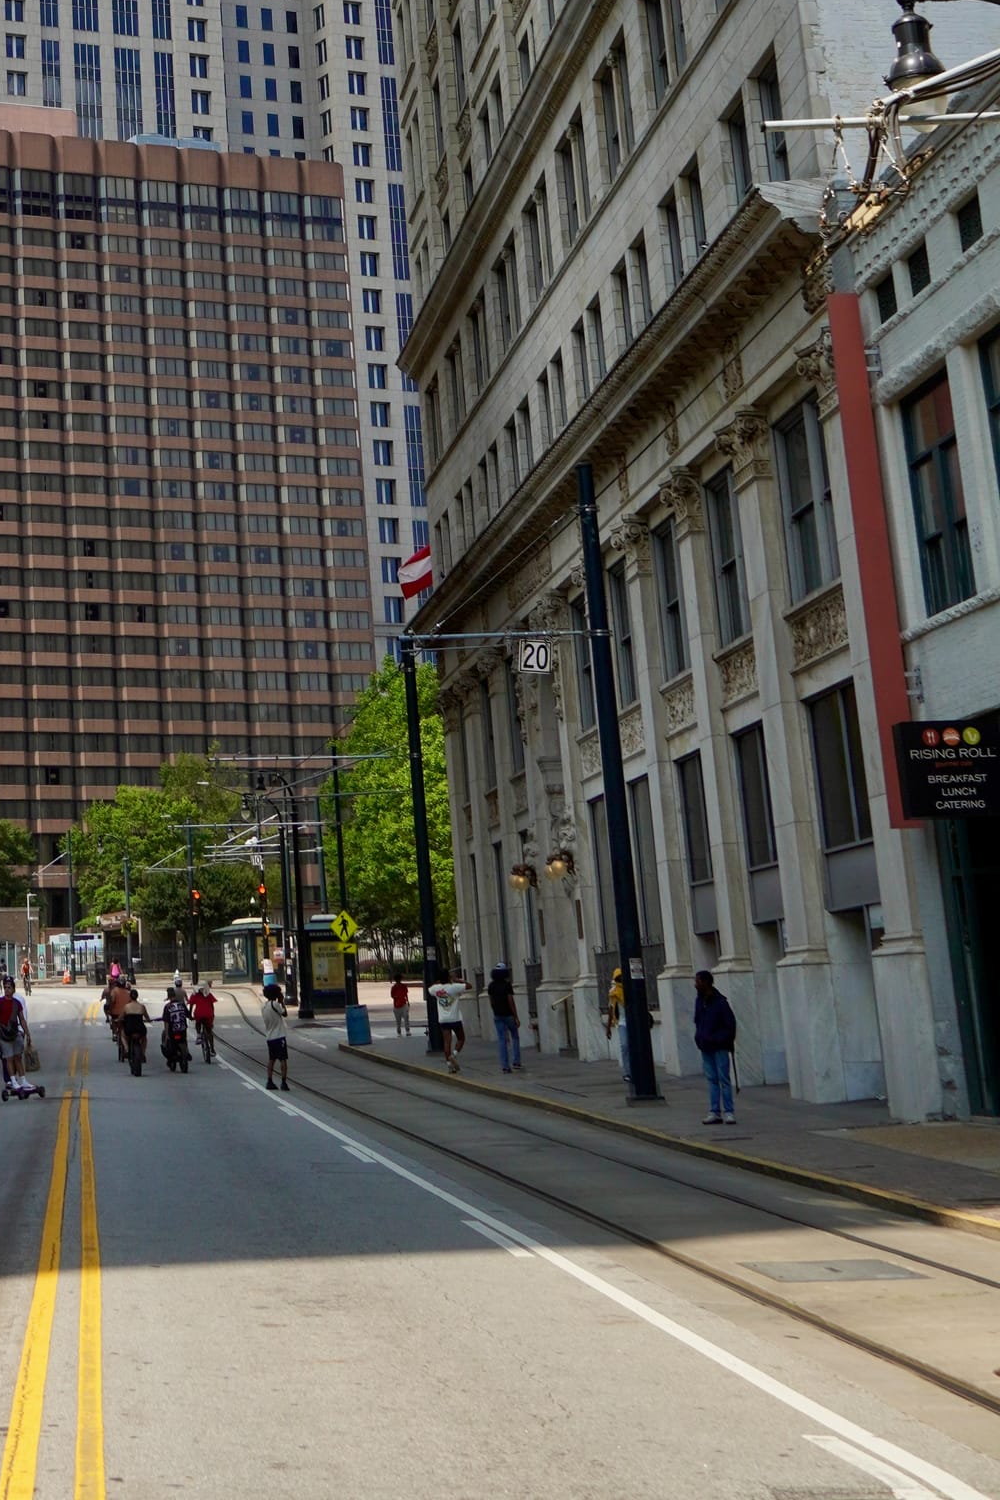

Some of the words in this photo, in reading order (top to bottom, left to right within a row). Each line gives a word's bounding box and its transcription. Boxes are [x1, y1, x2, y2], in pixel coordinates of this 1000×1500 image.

[524, 643, 548, 670] 20
[909, 748, 957, 760] RISING
[959, 747, 997, 758] ROLL
[927, 774, 988, 784] BREAKFAST
[941, 787, 977, 797] LUNCH
[935, 799, 986, 810] CATERING
